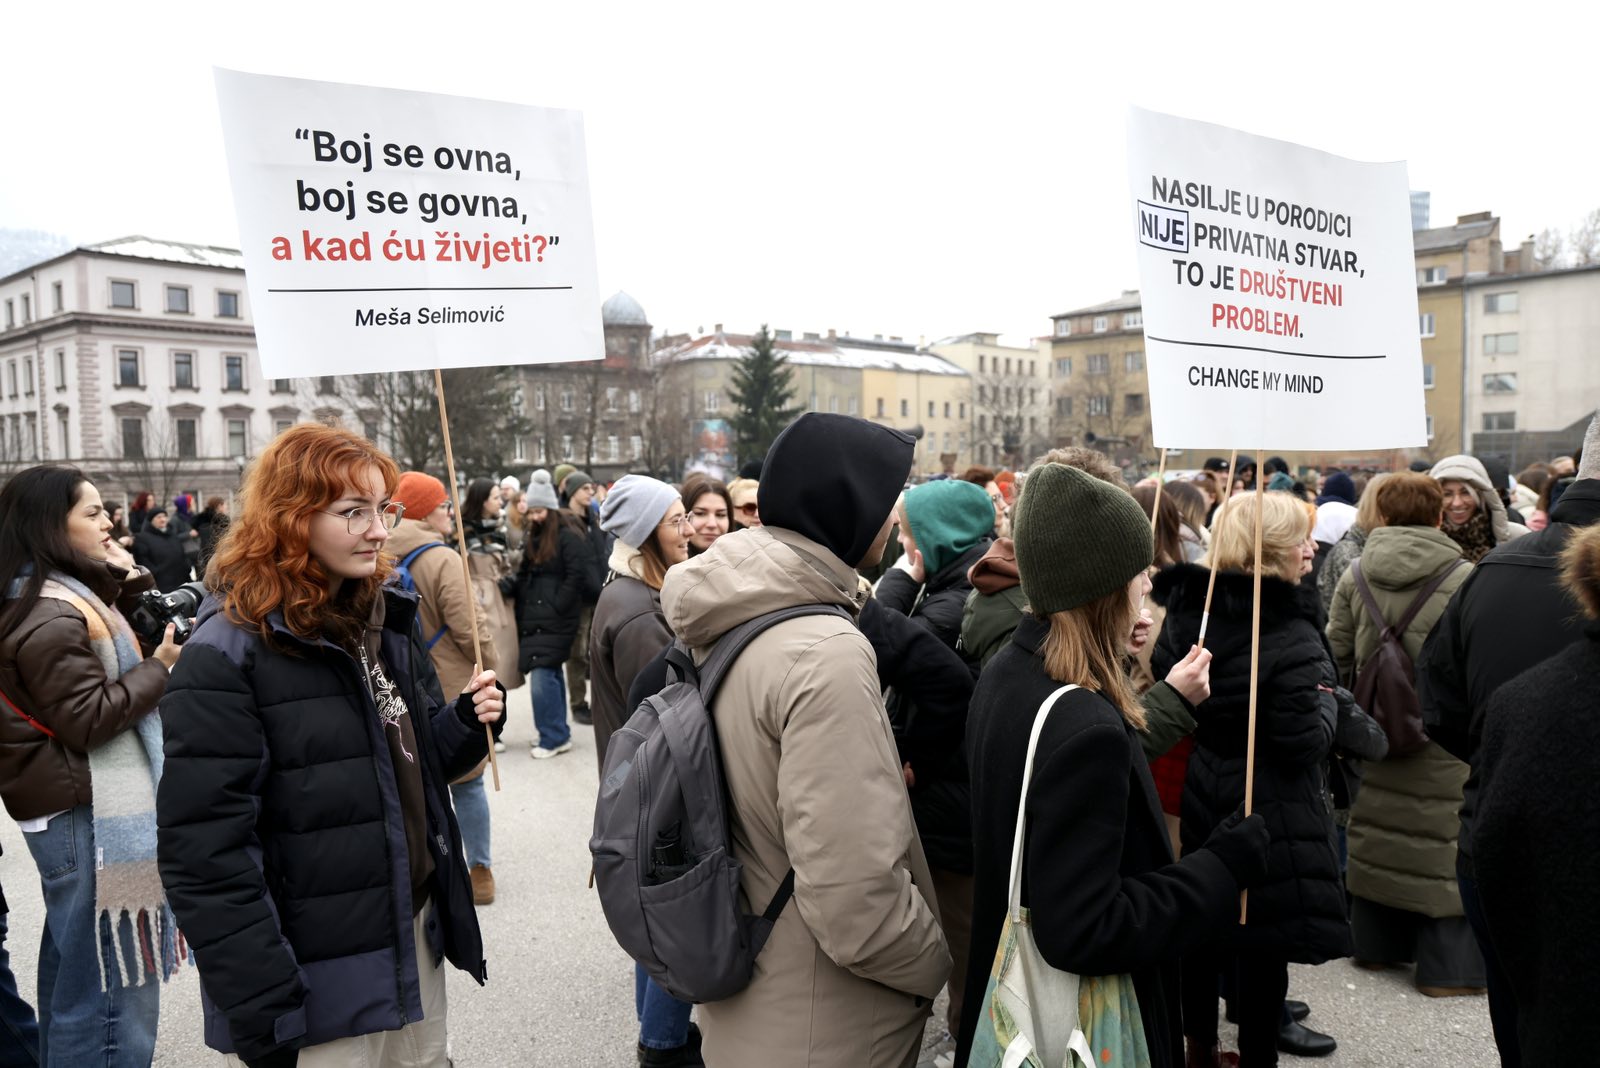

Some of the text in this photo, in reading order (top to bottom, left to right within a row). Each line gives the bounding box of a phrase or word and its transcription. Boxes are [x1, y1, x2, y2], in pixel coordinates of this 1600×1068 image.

[382, 143, 424, 169] se
[433, 146, 521, 181] ovna,
[296, 179, 528, 226] boj se govna,
[1152, 175, 1352, 238] NASILJE U PORODICI
[271, 236, 292, 261] a
[303, 229, 372, 262] kad
[382, 229, 426, 262] ću
[1141, 210, 1365, 279] NIJE PRIVATNA STVAR,
[1172, 259, 1343, 307] TO JE DRUŠTVENI
[355, 306, 505, 327] Meša Selimović
[1212, 303, 1304, 339] PROBLEM.
[1188, 365, 1324, 394] CHANGE MY MIND
